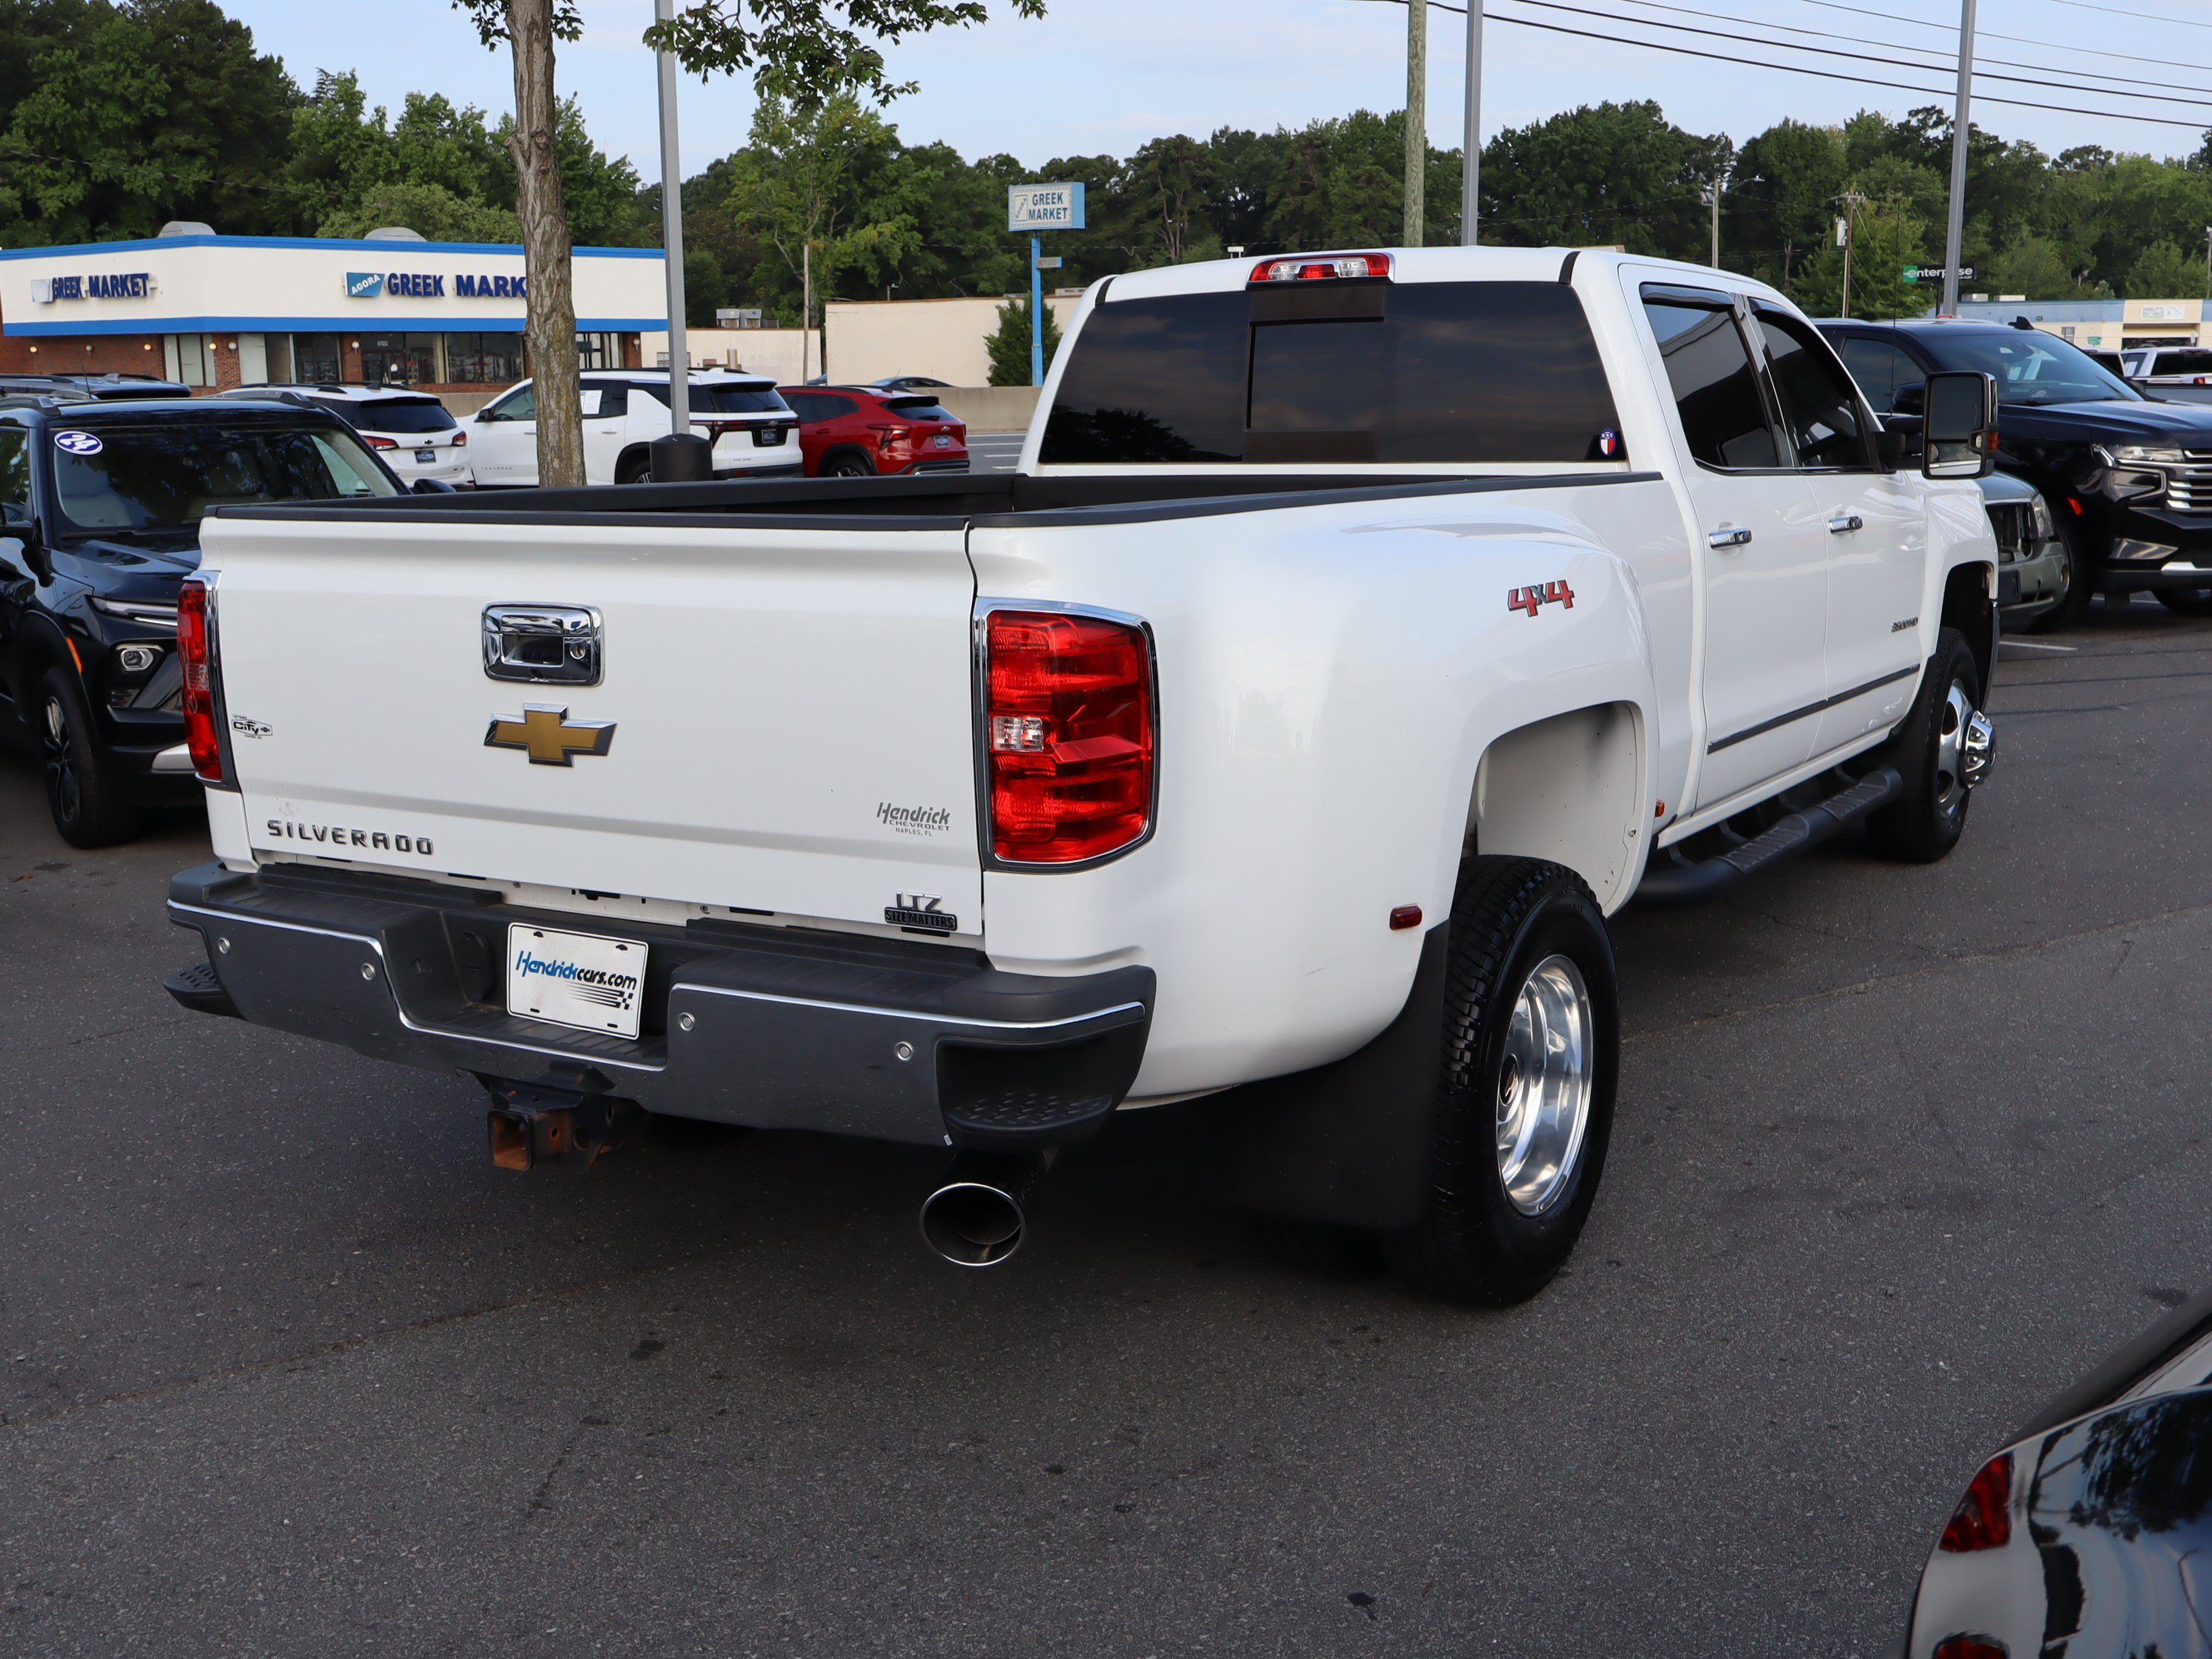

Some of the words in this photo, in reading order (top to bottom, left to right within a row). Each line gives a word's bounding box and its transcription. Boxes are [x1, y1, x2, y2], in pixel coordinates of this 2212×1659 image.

[1032, 192, 1064, 206] GREEK
[1029, 207, 1068, 221] MARKET
[1904, 267, 1973, 279] enterpse
[52, 276, 82, 299] GREEK
[88, 272, 149, 297] MARKET
[351, 274, 381, 295] AGORA
[387, 272, 445, 296] GREEK
[456, 275, 527, 297] MARK
[59, 434, 98, 451] 24
[876, 802, 950, 825] Hendrick
[889, 820, 950, 831] CHEVROLET
[895, 827, 923, 836] NAPLES,
[267, 820, 433, 855] SILVERADO
[896, 891, 943, 913] LTZ
[885, 909, 907, 923] SIZE
[908, 912, 954, 929] MATTERS
